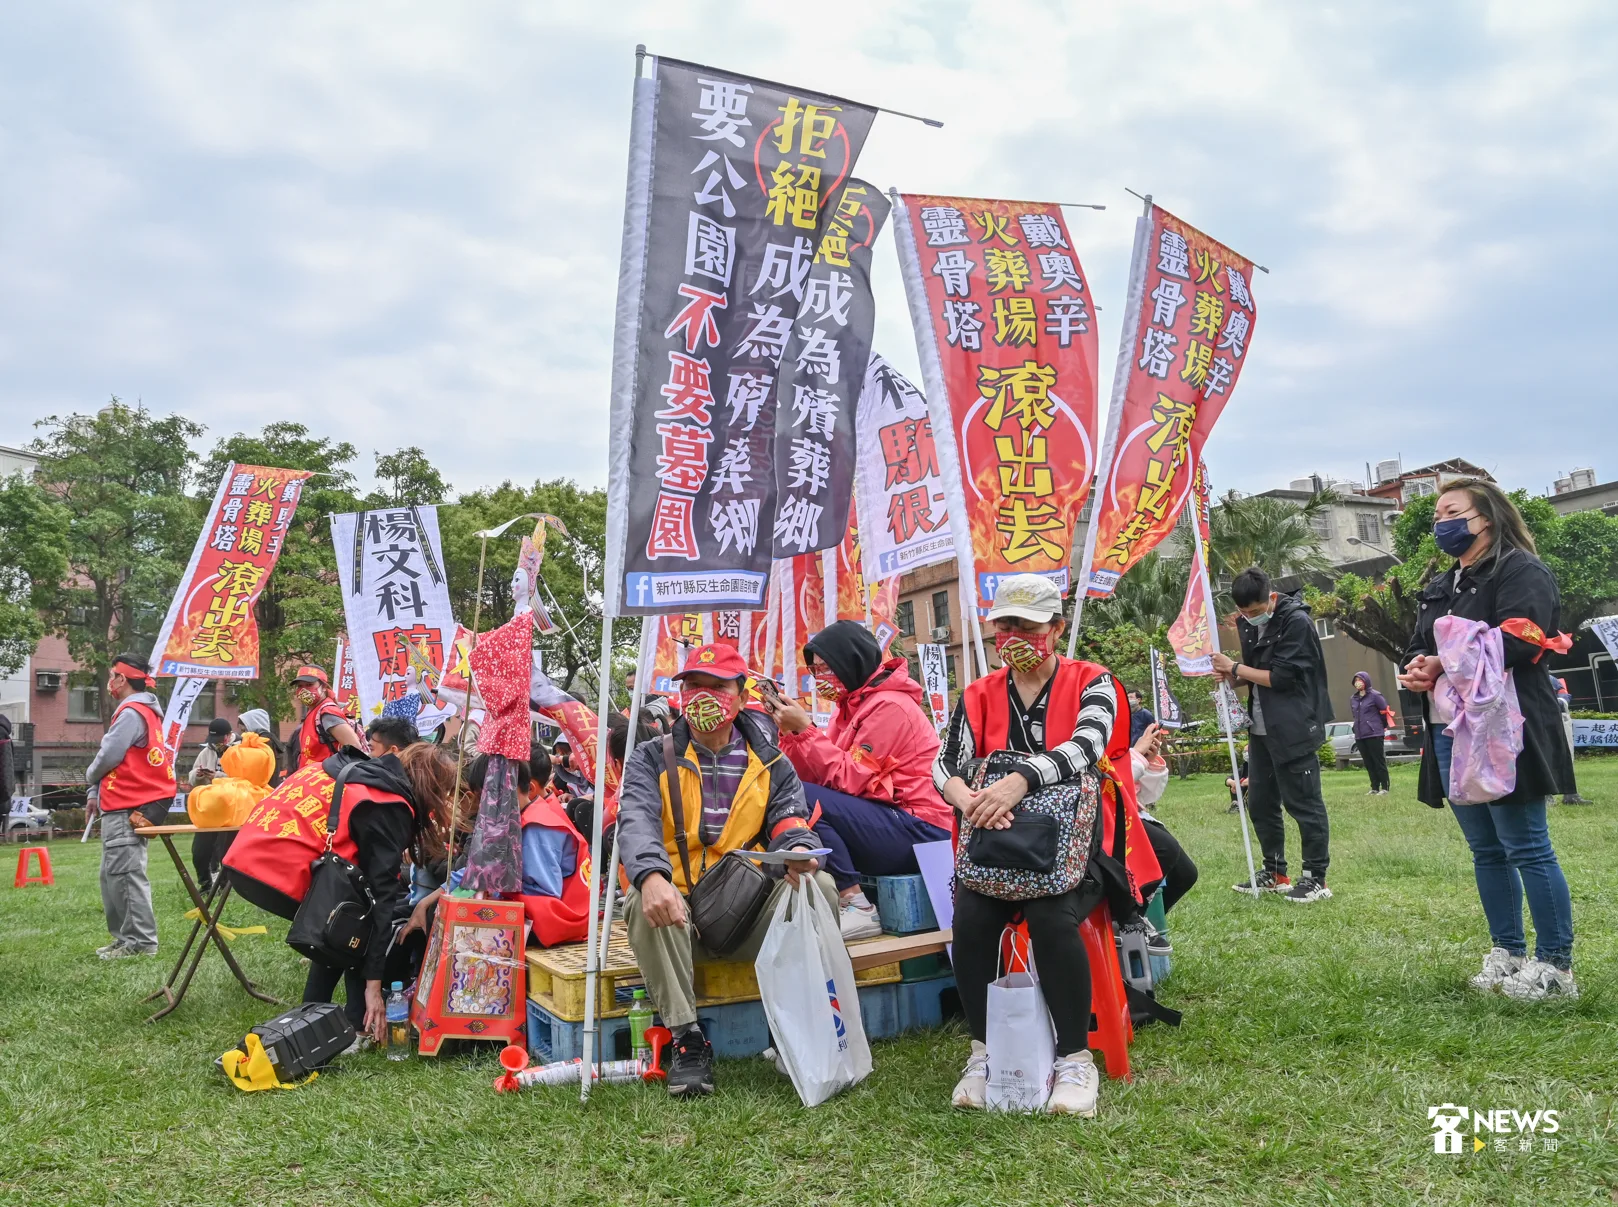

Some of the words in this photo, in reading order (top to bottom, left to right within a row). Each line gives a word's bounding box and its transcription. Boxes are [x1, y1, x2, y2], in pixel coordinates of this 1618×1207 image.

[920, 206, 985, 351] 靈骨塔
[974, 211, 1037, 348] 火葬場
[1018, 213, 1089, 348] 戴奧辛
[1139, 228, 1190, 379] 靈骨塔
[1179, 248, 1224, 391] 火葬場
[1204, 265, 1254, 399] 戴奧辛
[210, 473, 254, 552] 靈骨塔
[238, 477, 280, 556] 火葬場
[978, 361, 1065, 564] 滾出去
[1106, 392, 1197, 565] 滾出去
[190, 558, 265, 662] 滾出去
[365, 512, 428, 621] 楊文科
[926, 646, 939, 691] 楊文科
